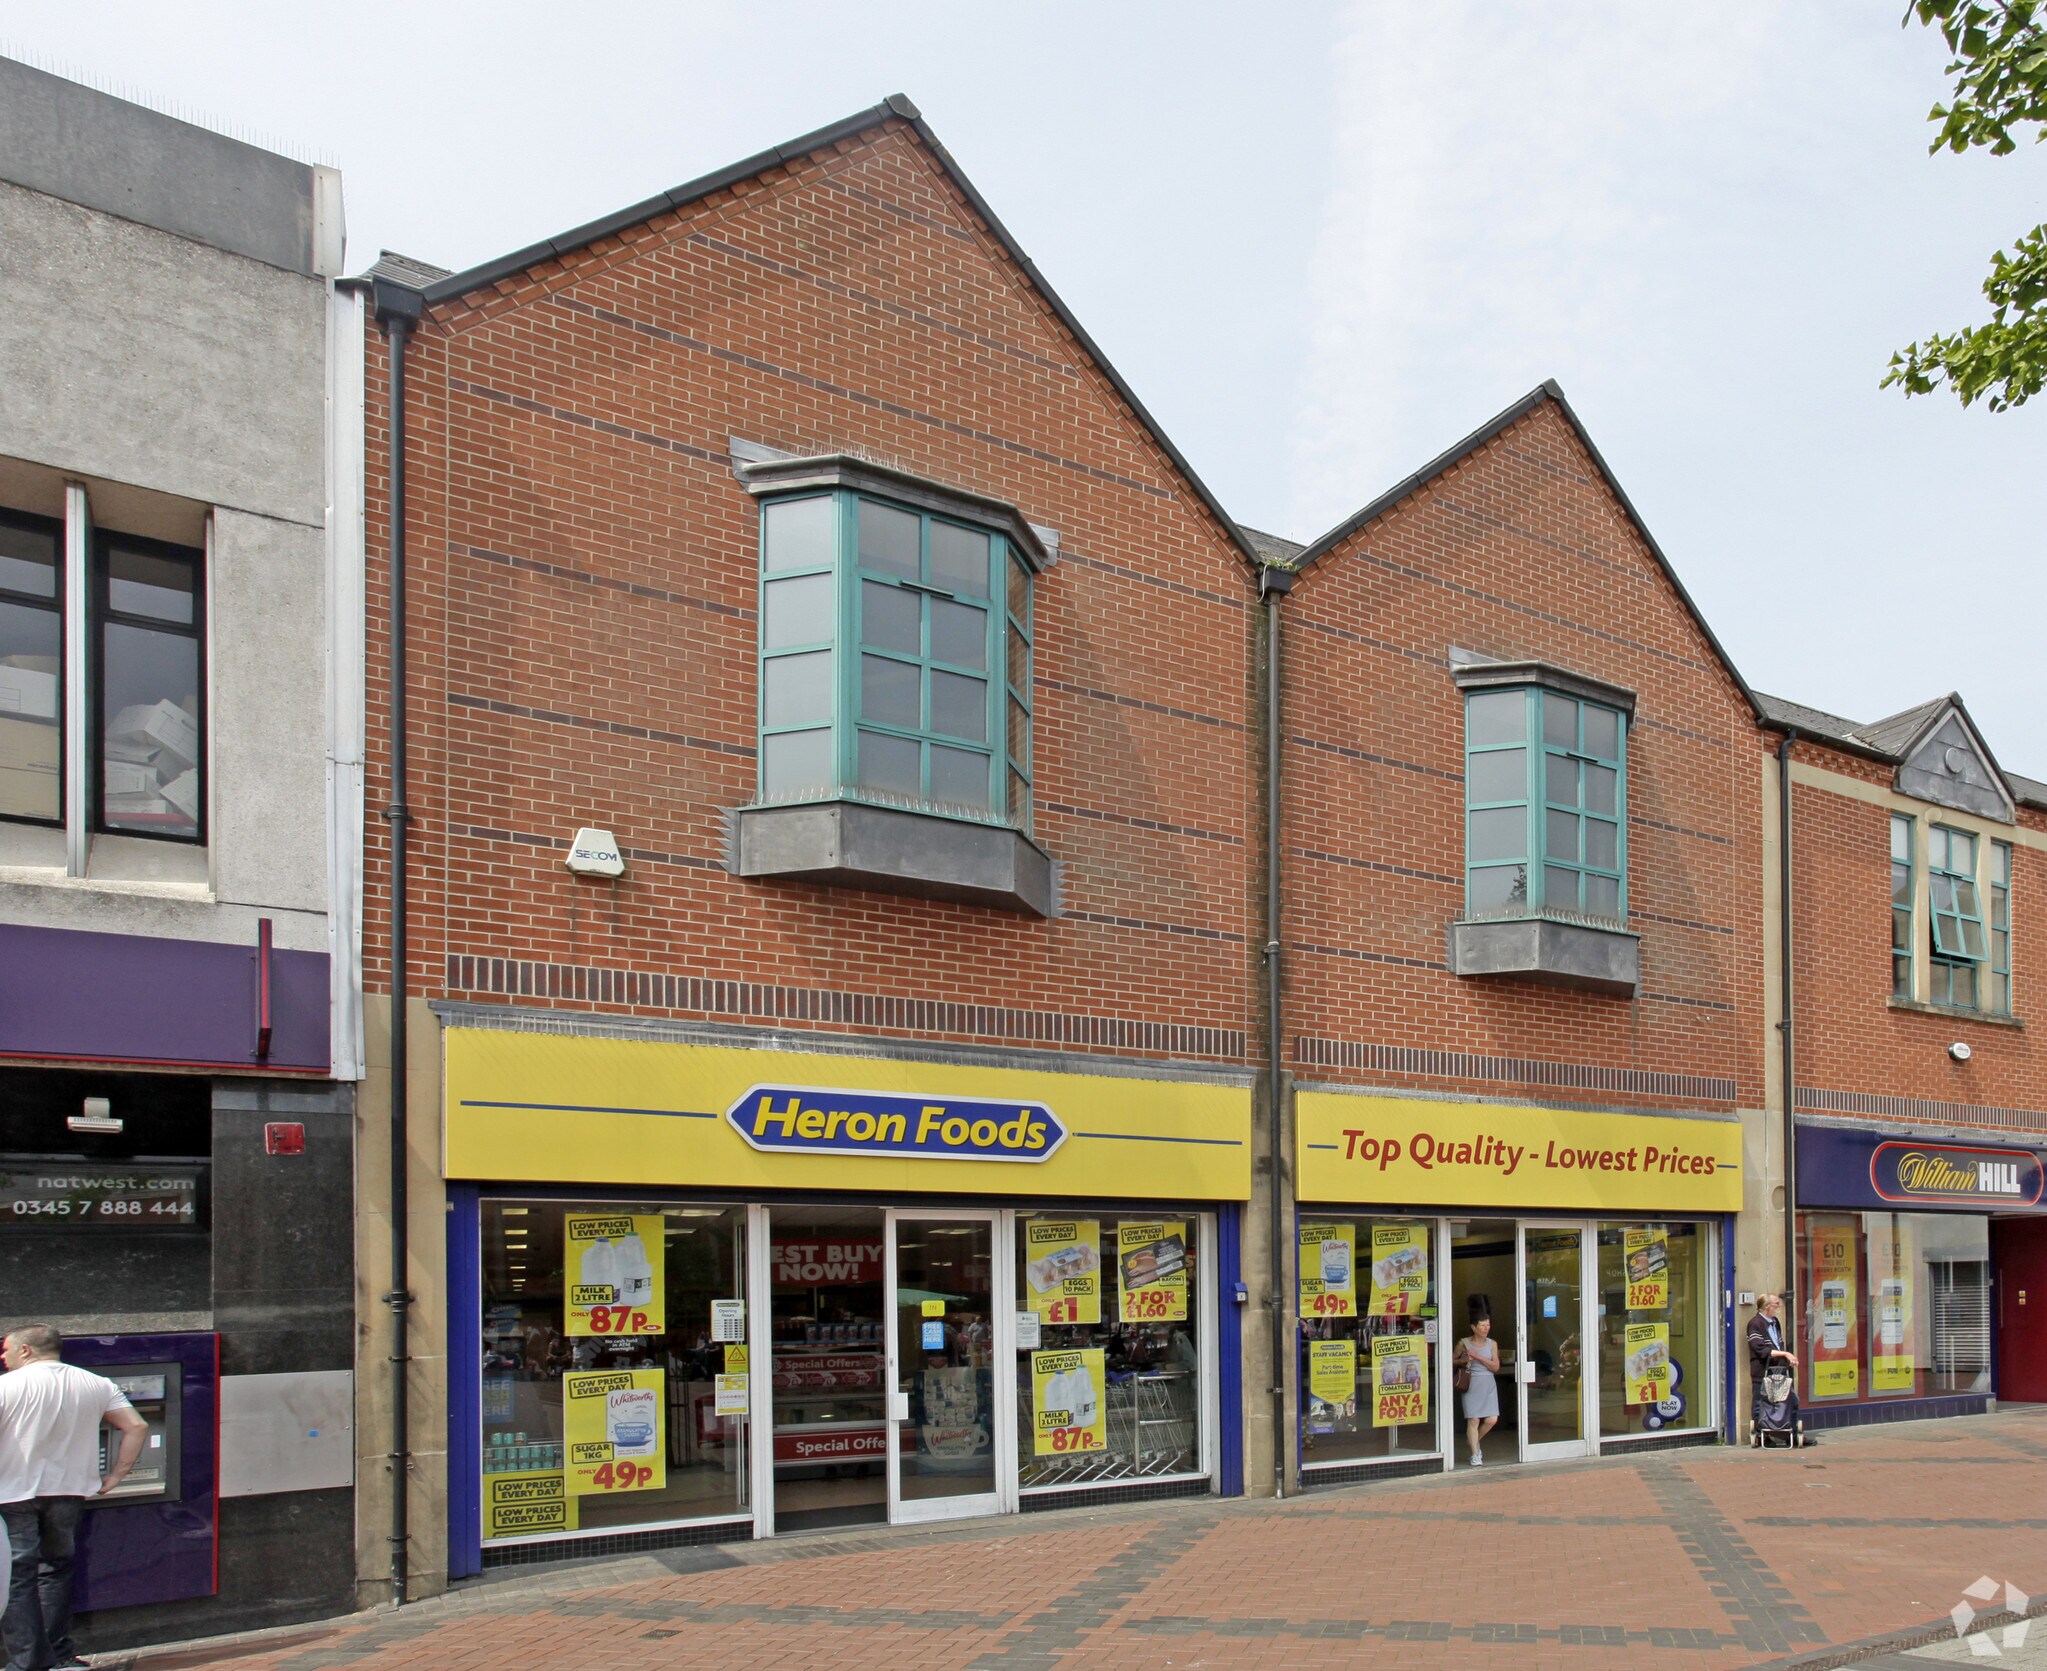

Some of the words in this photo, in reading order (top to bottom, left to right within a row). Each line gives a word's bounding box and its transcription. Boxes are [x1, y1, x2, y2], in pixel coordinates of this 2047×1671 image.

[576, 850, 617, 861] SECOM
[753, 1096, 906, 1143] Heron
[915, 1106, 1047, 1148] Foods
[1343, 1129, 1401, 1171] Top
[1409, 1133, 1525, 1176] Quality
[1545, 1140, 1637, 1173] Lowest
[1643, 1146, 1716, 1175] Prices
[1897, 1152, 1979, 1192] William
[1979, 1162, 2021, 1193] HILL
[37, 1176, 194, 1190] natwest.com
[12, 1200, 71, 1215] 0345
[78, 1201, 92, 1215] 7
[100, 1201, 142, 1215] 888
[149, 1201, 194, 1215] 444
[573, 1222, 596, 1230] LOW
[770, 1245, 819, 1263] EST
[826, 1245, 884, 1262] BUY
[1823, 1244, 1844, 1258] £10
[779, 1263, 859, 1281] NOW!
[1630, 1285, 1635, 1295] 2
[1638, 1285, 1661, 1295] FOR
[1126, 1292, 1136, 1305] 2
[1140, 1290, 1176, 1304] FOR
[1385, 1292, 1409, 1313] £1
[1630, 1295, 1655, 1306] £1.60
[1048, 1297, 1077, 1322] £1
[1126, 1304, 1167, 1318] £1.60
[785, 1359, 824, 1371] Special
[826, 1359, 861, 1368] Offers
[573, 1380, 596, 1389] LOW
[598, 1376, 629, 1385] PRICES
[577, 1386, 605, 1395] EVERY
[608, 1384, 627, 1392] DAY
[1639, 1382, 1657, 1402] £1
[1379, 1394, 1411, 1408] ANY
[1412, 1394, 1420, 1405] 4
[484, 1406, 510, 1416] ERE
[1379, 1406, 1407, 1419] FOR
[1410, 1405, 1423, 1417] £1
[575, 1444, 610, 1452] SUGAR
[796, 1438, 850, 1456] Special
[853, 1437, 886, 1450] Offe
[498, 1483, 524, 1491] LOW
[525, 1479, 562, 1489] PRICES
[502, 1490, 534, 1499] EVERY
[537, 1487, 558, 1496] DAY
[498, 1509, 524, 1517] LOW
[525, 1505, 562, 1515] PRICES
[502, 1516, 534, 1525] EVERY
[537, 1513, 558, 1522] DAY
